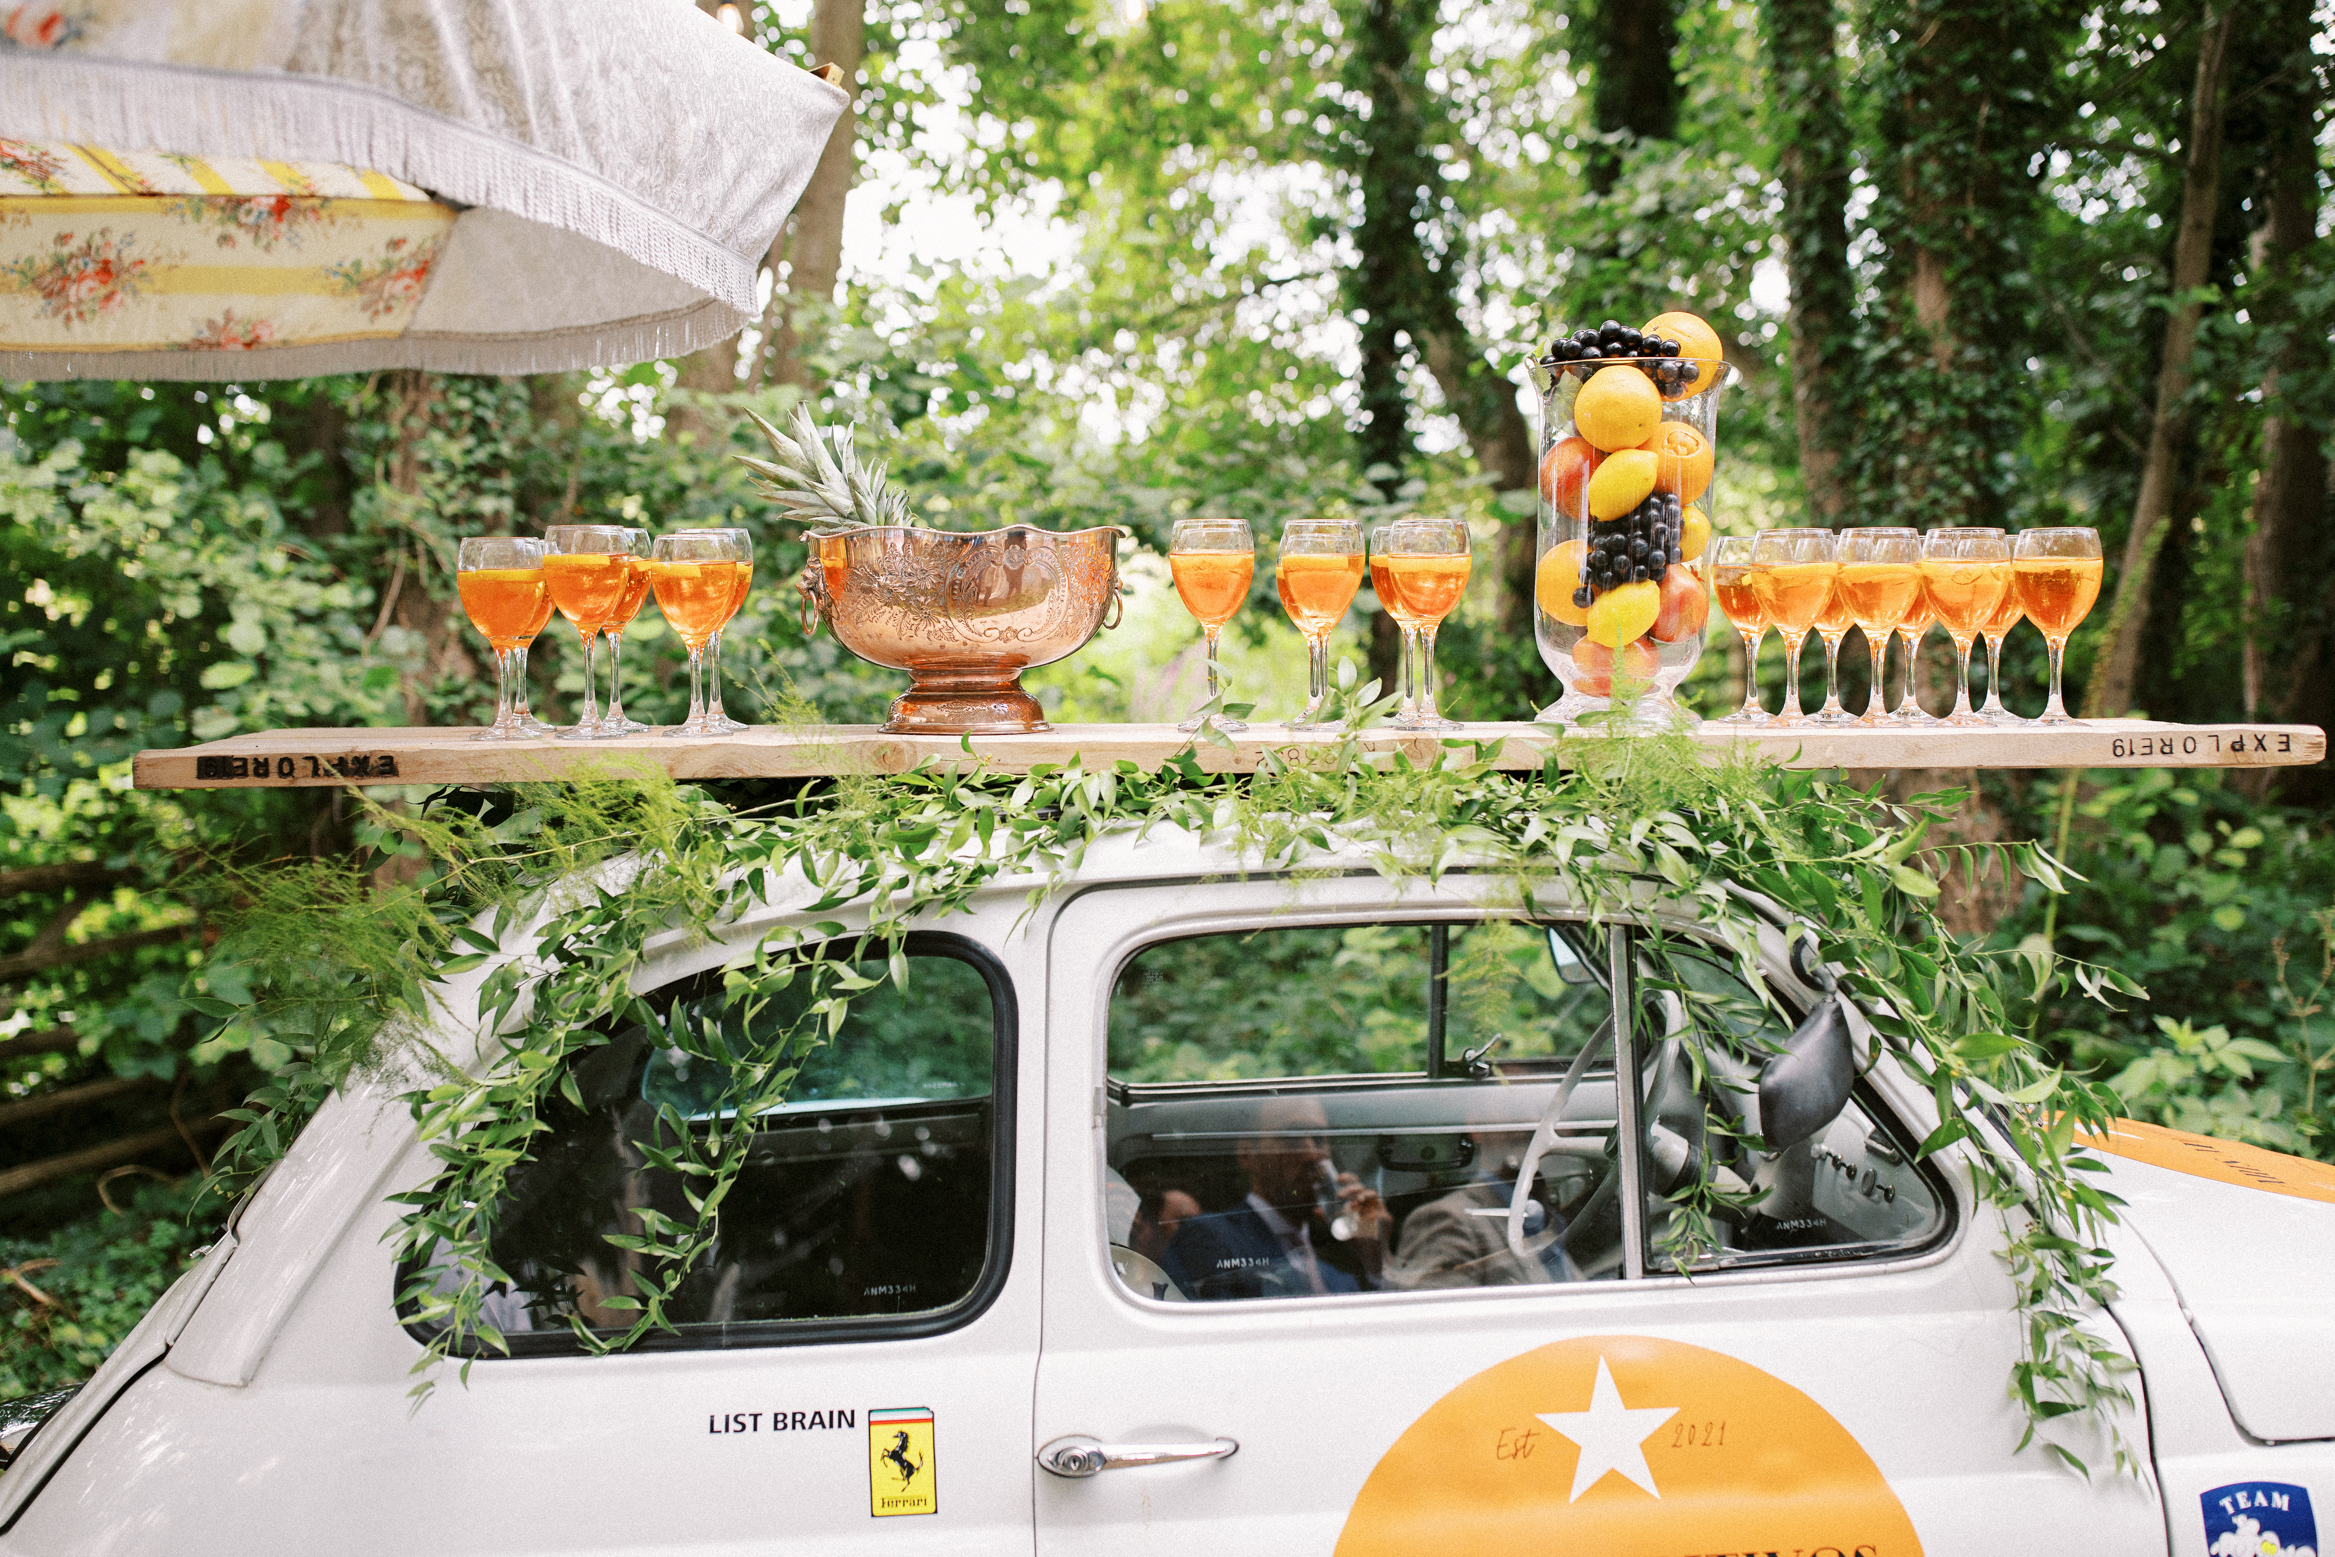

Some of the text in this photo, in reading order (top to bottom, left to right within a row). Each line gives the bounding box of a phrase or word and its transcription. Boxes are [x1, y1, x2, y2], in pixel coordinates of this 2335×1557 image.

[2112, 733, 2291, 757] EXPLORE19
[709, 1409, 856, 1434] LIST BRAIN
[1496, 1420, 1727, 1461] Est 2021
[881, 1495, 928, 1509] Ferrari
[2218, 1490, 2290, 1515] TEAM
